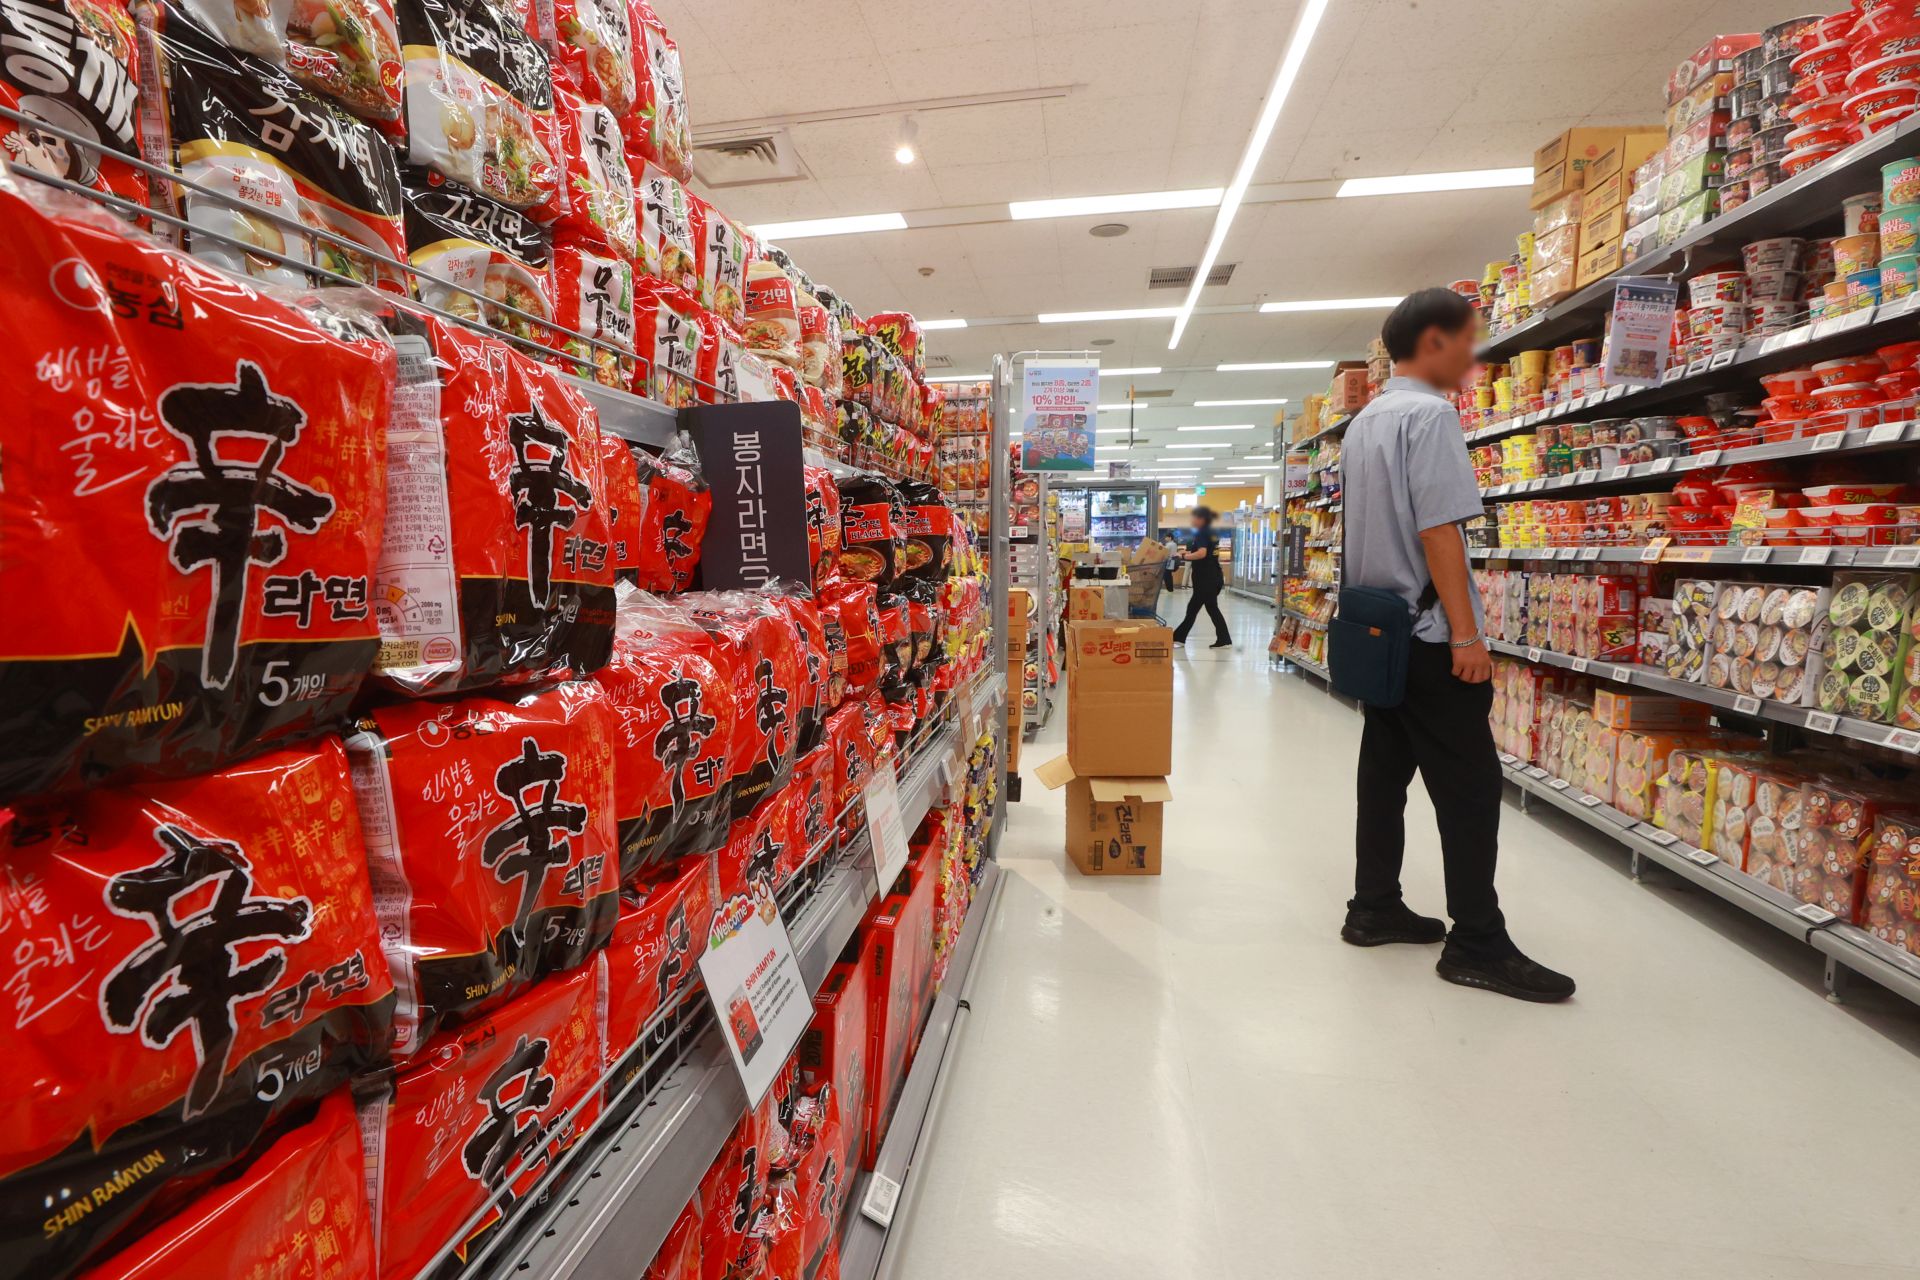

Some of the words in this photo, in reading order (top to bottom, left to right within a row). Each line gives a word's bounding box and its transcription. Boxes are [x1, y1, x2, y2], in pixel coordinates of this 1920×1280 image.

[762, 287, 788, 305] 건면
[1032, 394, 1052, 406] 10%
[507, 397, 595, 609] 辛
[1287, 479, 1306, 488] 3,380
[144, 359, 337, 691] 辛
[850, 528, 883, 541] BLACK
[262, 569, 369, 629] 라면
[1099, 641, 1132, 656] 진라면
[257, 659, 328, 708] 5개입
[480, 736, 589, 948] 辛
[0, 865, 51, 934] 생을
[713, 903, 748, 942] Welcome
[100, 821, 313, 1122] 辛
[756, 946, 777, 977] RAMYUN
[261, 949, 371, 1029] 라면
[465, 983, 491, 1000] SHIN
[257, 1044, 323, 1101] 5개입
[43, 1196, 94, 1241] SHIN
[94, 1149, 166, 1209] RAMYUN
